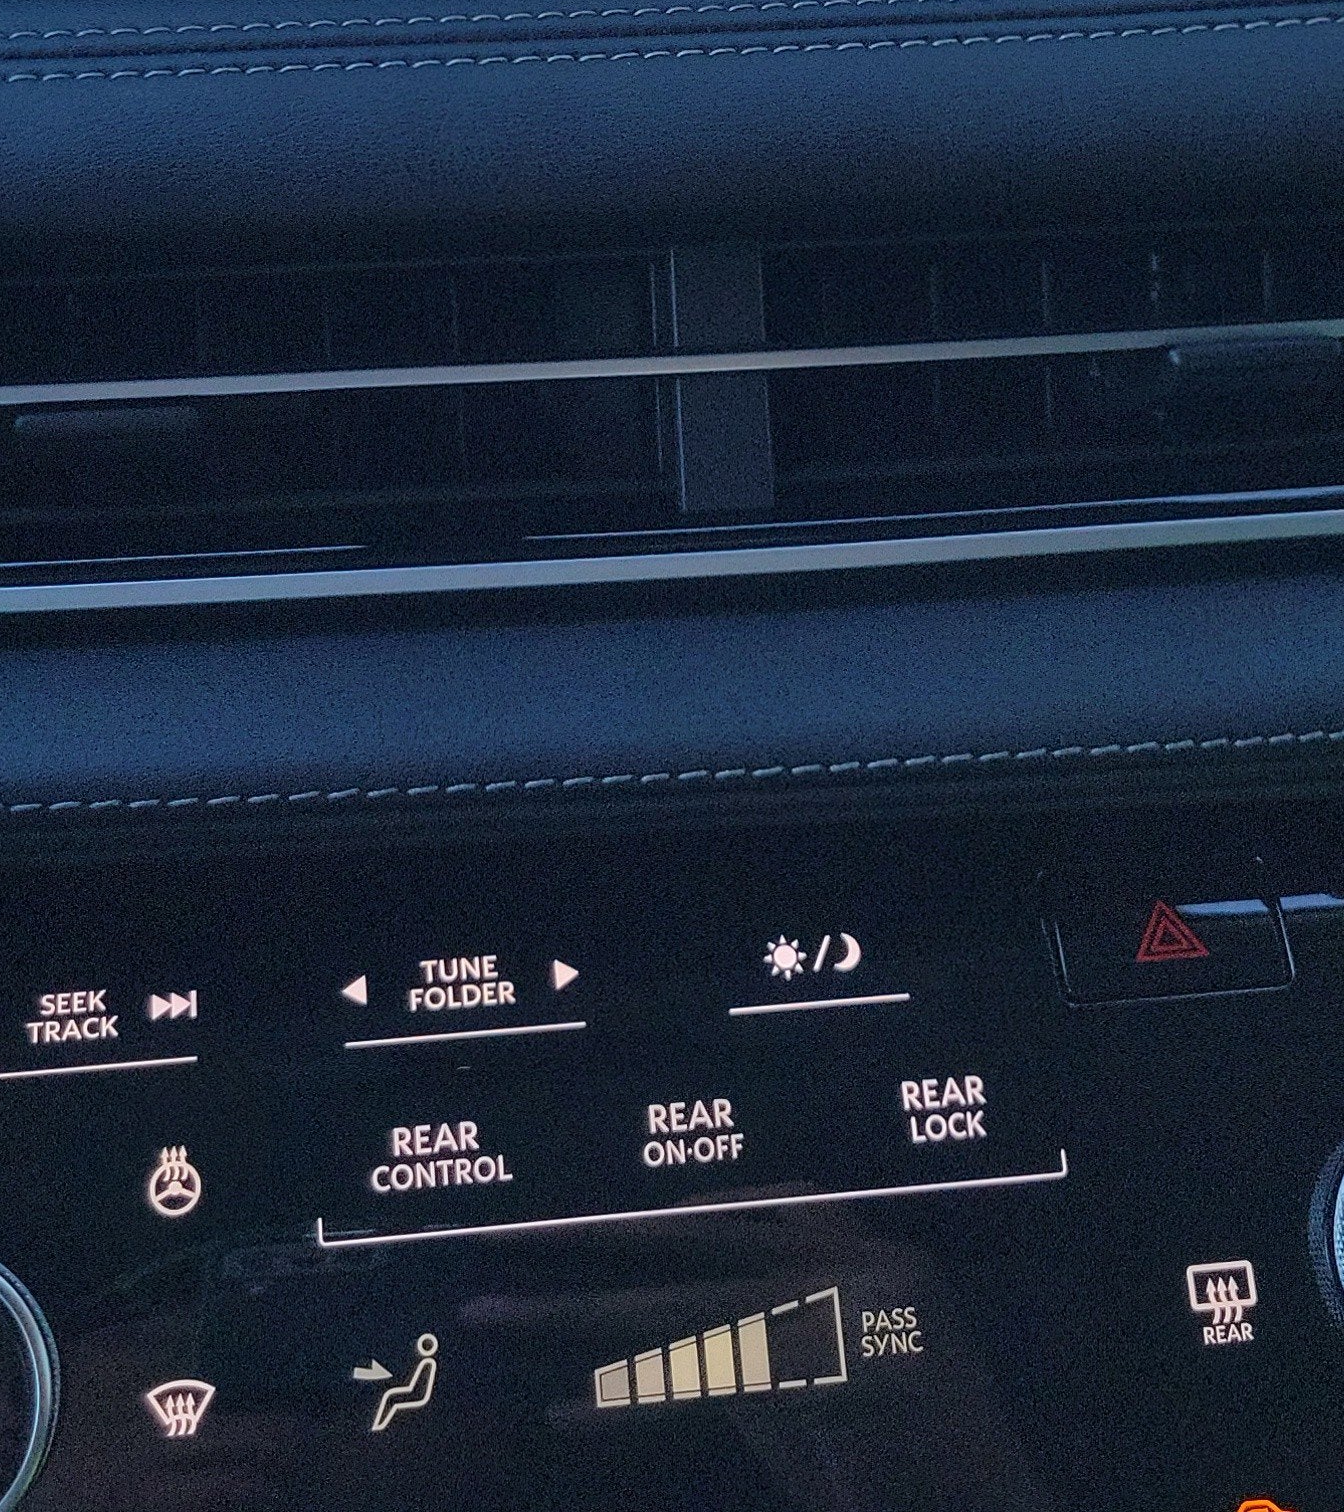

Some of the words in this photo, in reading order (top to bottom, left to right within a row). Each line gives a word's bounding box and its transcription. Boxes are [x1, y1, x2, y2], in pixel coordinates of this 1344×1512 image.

[419, 955, 498, 983] TUNE
[40, 989, 106, 1016] SEEK
[409, 981, 515, 1011] FOLDER
[26, 1015, 118, 1043] TRACK
[901, 1076, 986, 1111] REAR
[648, 1099, 734, 1134] REAR
[910, 1110, 986, 1143] LOCK
[392, 1121, 479, 1157] REAR
[371, 1155, 513, 1192] CONTROL
[862, 1307, 917, 1333] PASS
[1203, 1323, 1254, 1345] REAR
[861, 1331, 923, 1357] SYNC
